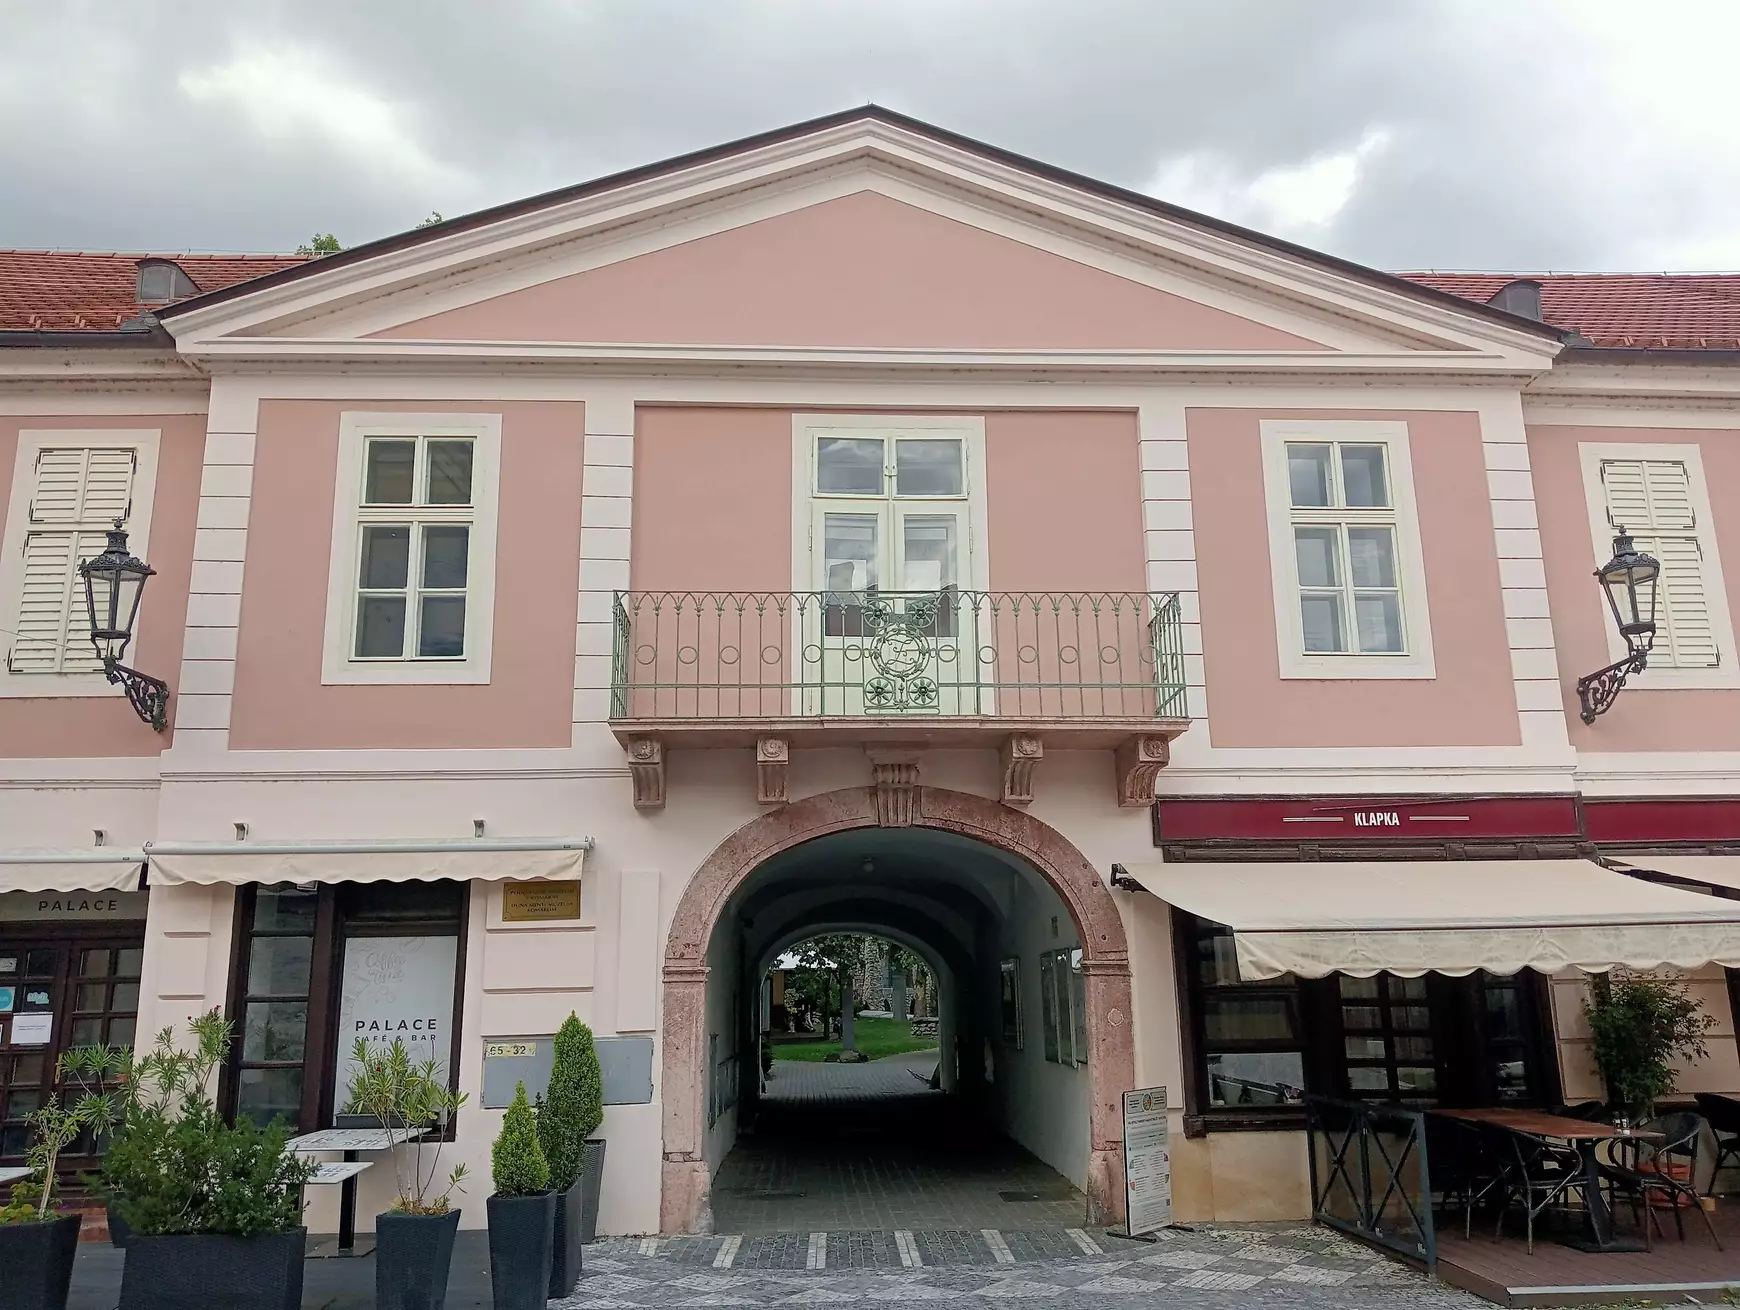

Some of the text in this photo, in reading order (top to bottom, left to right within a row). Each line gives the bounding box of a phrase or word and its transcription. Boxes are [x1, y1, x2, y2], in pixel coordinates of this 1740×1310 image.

[1354, 812, 1400, 827] KLAPKA
[38, 900, 118, 912] PALACE
[355, 1018, 437, 1032] PALACE
[354, 1034, 387, 1042] CAFÉ
[411, 1034, 436, 1042] BAR
